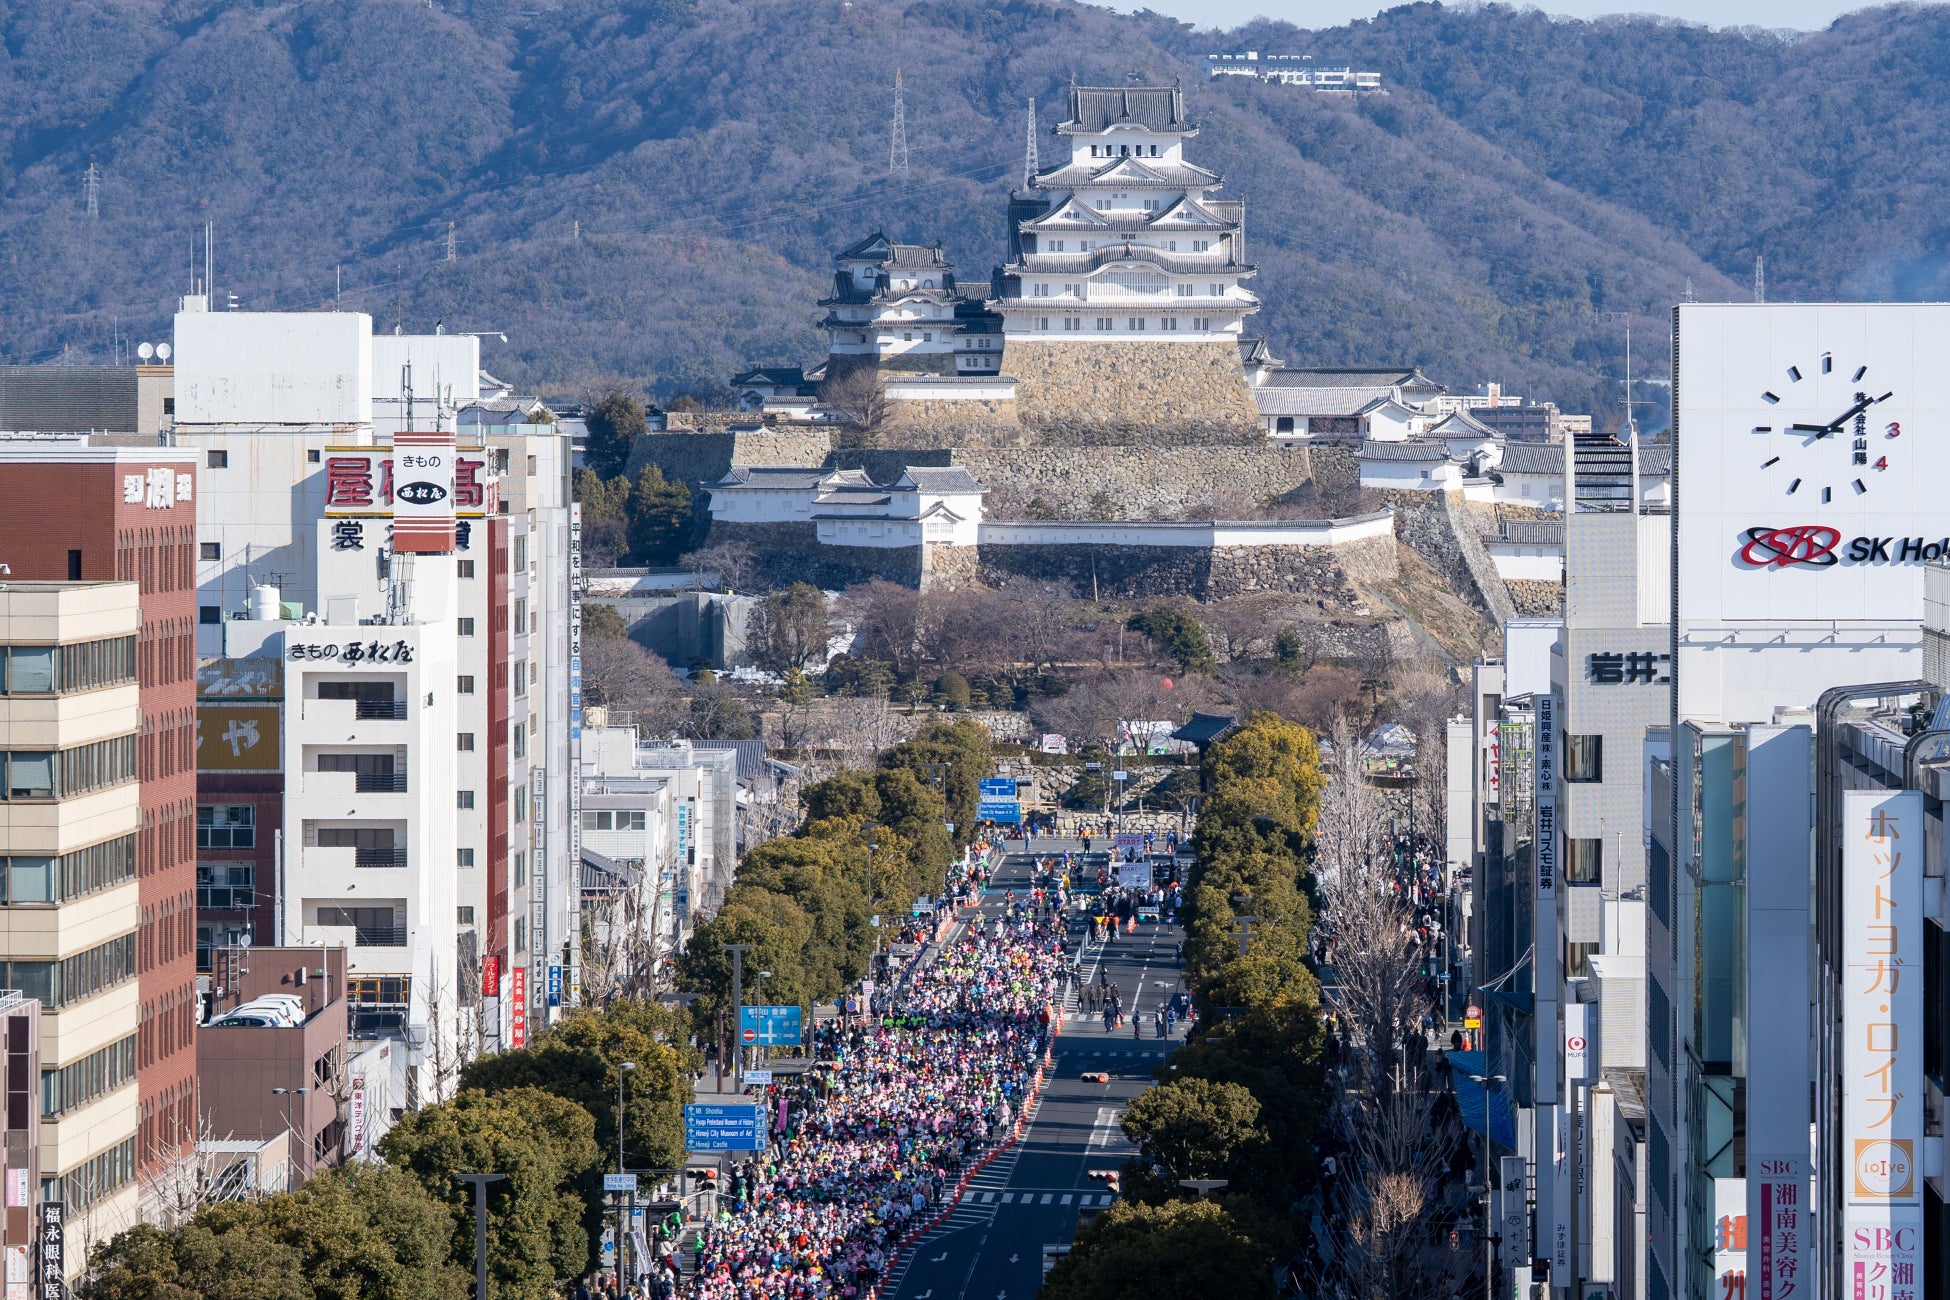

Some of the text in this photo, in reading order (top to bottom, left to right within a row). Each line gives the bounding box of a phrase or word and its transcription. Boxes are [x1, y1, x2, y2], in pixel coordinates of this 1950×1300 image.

[1855, 392, 1867, 465] 株会社山陽
[1889, 422, 1900, 437] 3
[403, 456, 441, 467] きもの
[1876, 456, 1888, 470] 4
[401, 487, 443, 499] 西松屋
[1849, 537, 1894, 561] SK
[572, 523, 580, 654] 平和を仕事にする
[291, 643, 339, 659] きもの
[1540, 805, 1553, 890] 岩井コスモ証券
[1864, 809, 1904, 1129] ホットヨガ・ロイブ
[696, 1130, 709, 1138] Himeji
[710, 1130, 719, 1138] City
[696, 1141, 710, 1149] Himeji
[1761, 1160, 1797, 1175] SBC
[1557, 1224, 1566, 1267] みずほ証券
[1854, 1227, 1915, 1251] SBC
